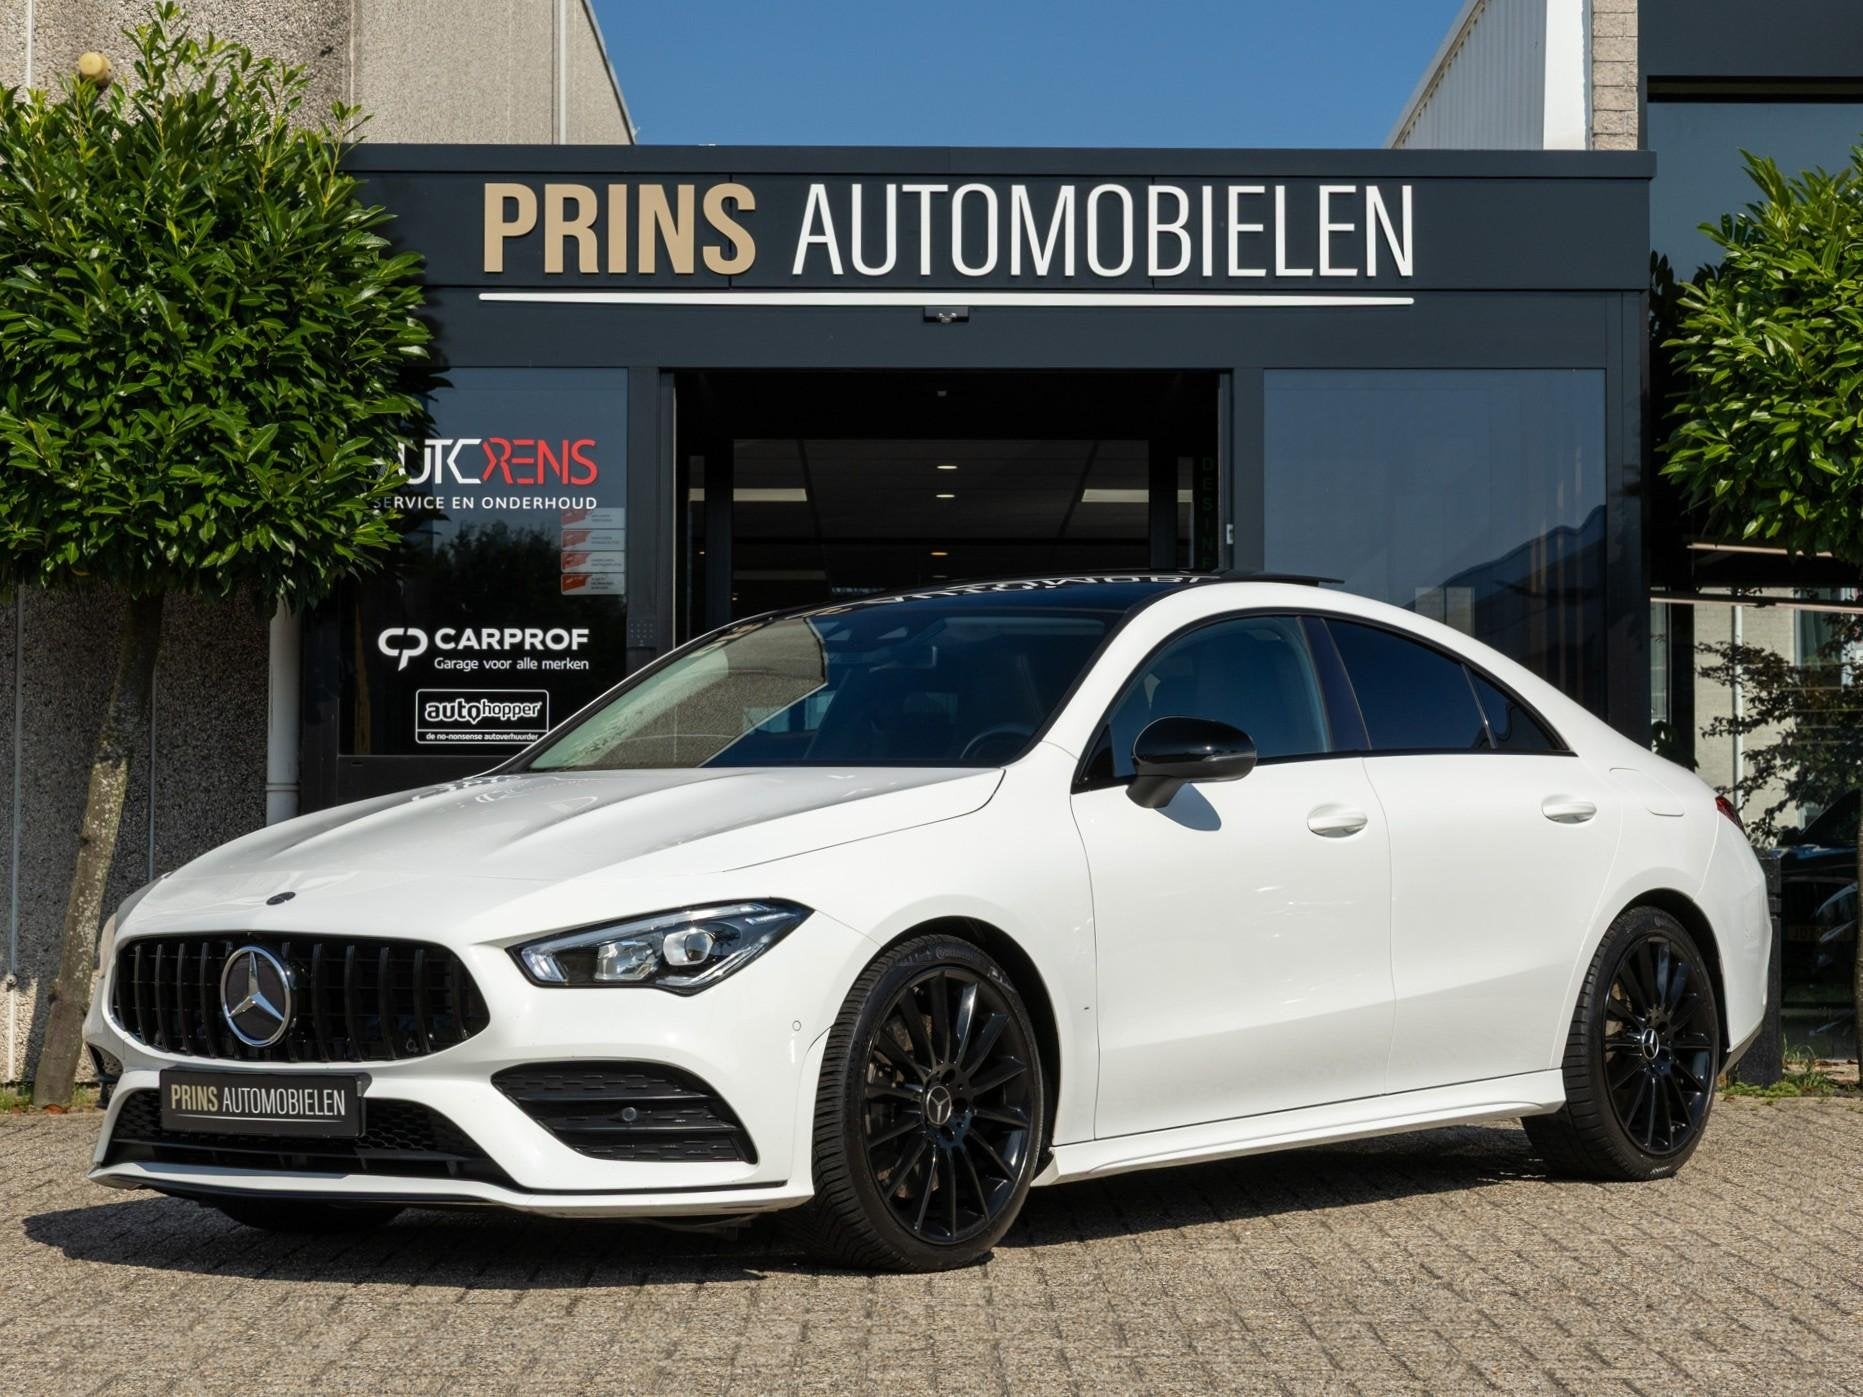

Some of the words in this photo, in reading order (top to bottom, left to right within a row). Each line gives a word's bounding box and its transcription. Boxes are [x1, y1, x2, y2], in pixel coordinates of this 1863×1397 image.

[483, 182, 757, 276] PRINS
[792, 182, 1414, 278] AUTOMOBIELEN
[373, 496, 445, 510] SERVICE
[452, 496, 474, 510] EN
[481, 496, 598, 510] ONDERHOUD
[434, 628, 590, 650] CARPROF
[434, 657, 479, 671] Garage
[483, 659, 512, 670] voor
[516, 657, 537, 670] alle
[542, 657, 590, 670] merken
[425, 698, 543, 725] autohopper
[426, 733, 436, 741] de
[437, 733, 482, 741] no-nonsense
[171, 1084, 219, 1112] PRINS
[222, 1087, 346, 1116] AUTOMOBIELEN
